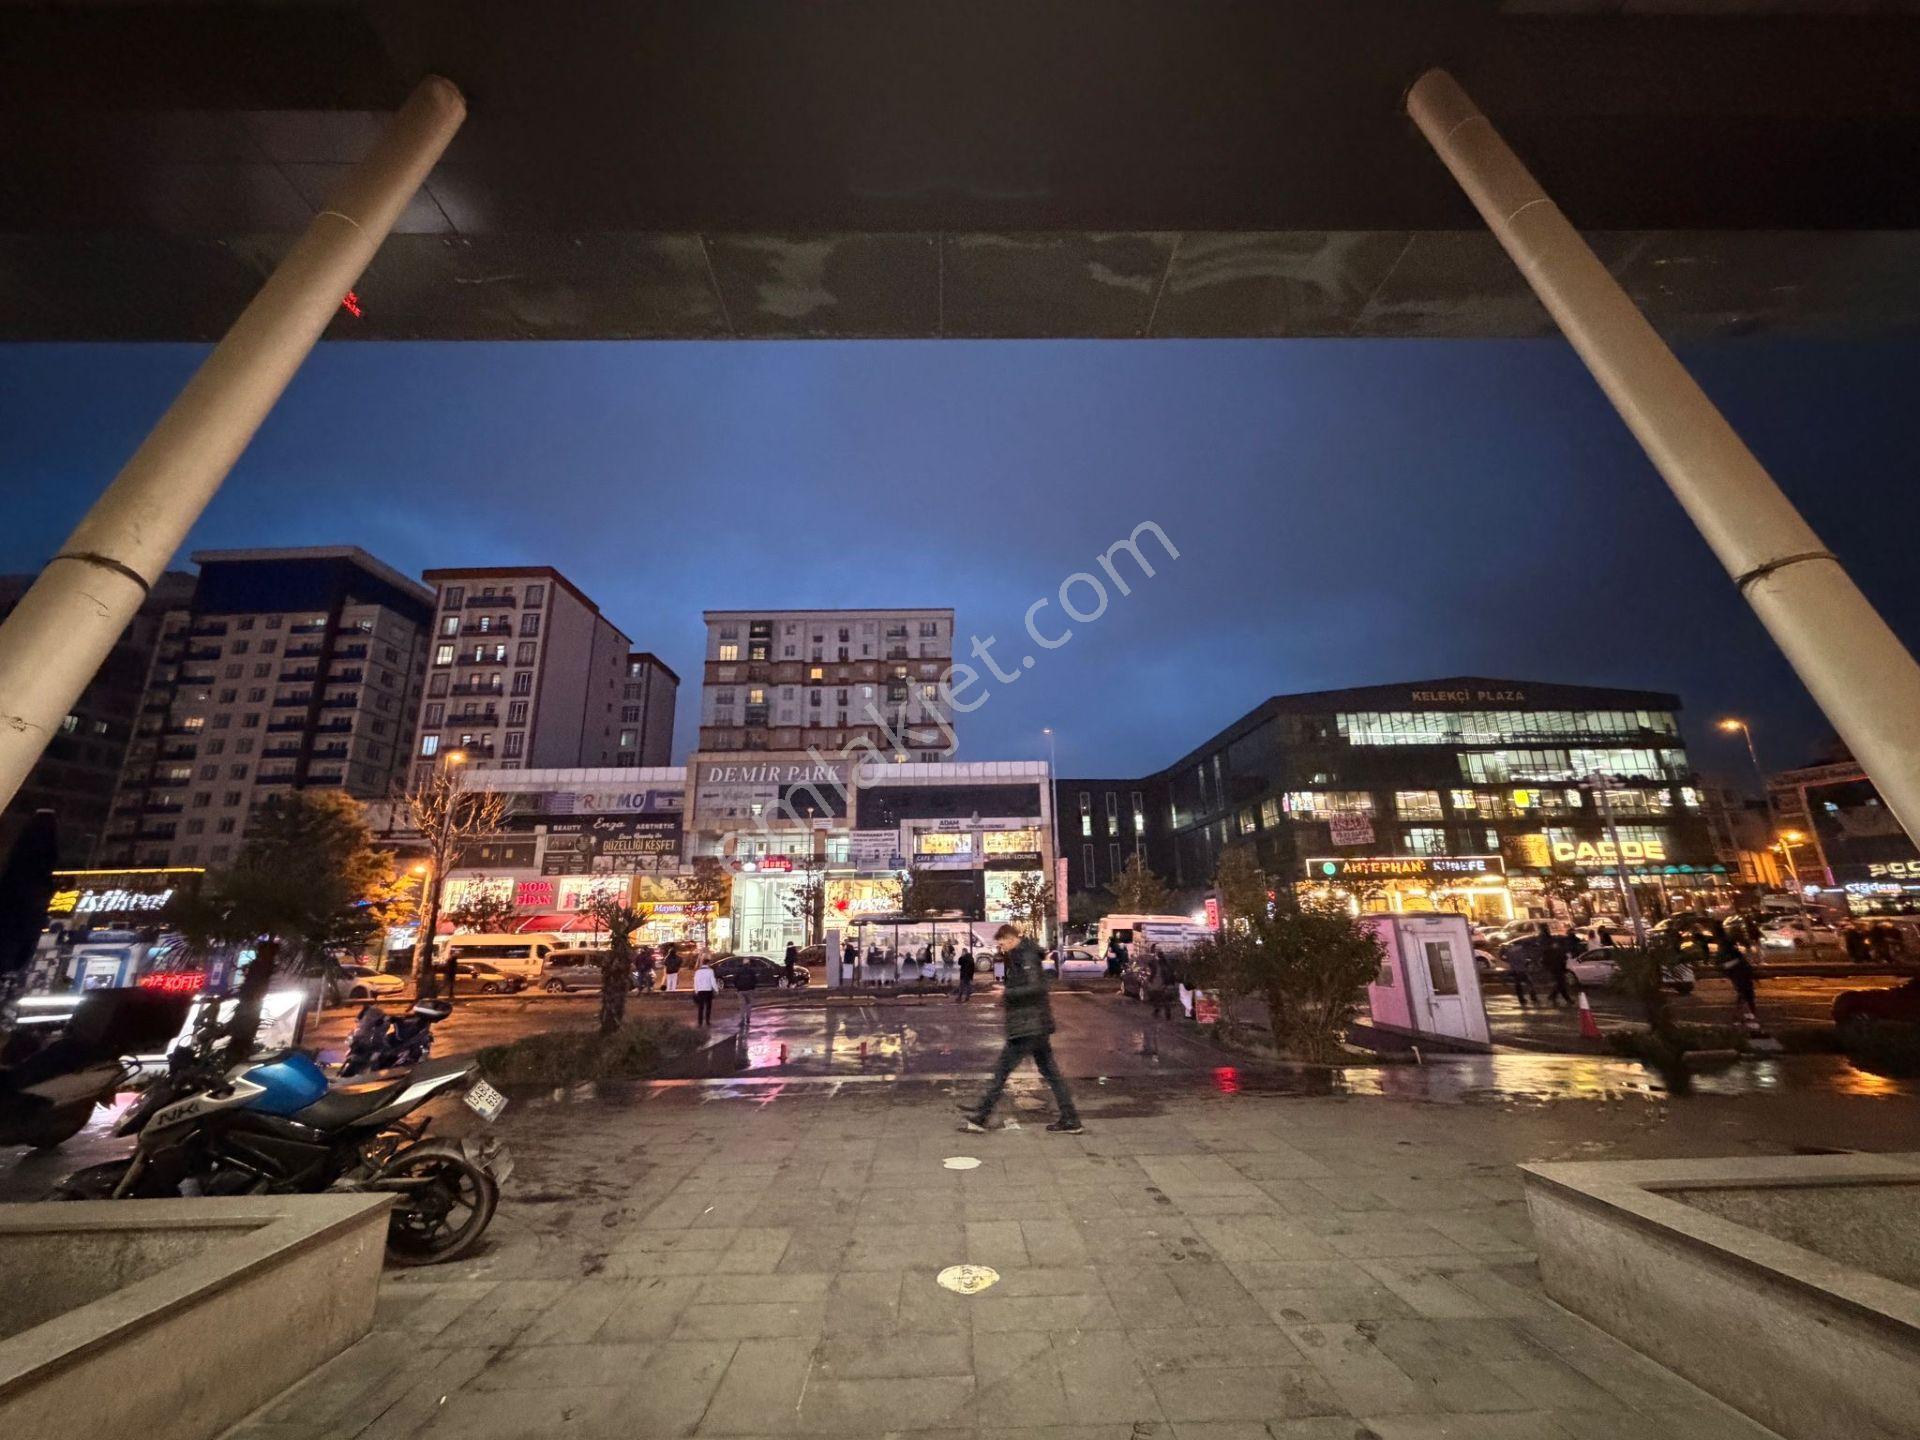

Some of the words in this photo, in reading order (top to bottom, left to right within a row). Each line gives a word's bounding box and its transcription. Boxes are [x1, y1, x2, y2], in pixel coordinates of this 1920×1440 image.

[1411, 689, 1470, 703] KELEKÇİ
[1477, 691, 1525, 701] PLAZA
[708, 762, 781, 782] DEMİR
[787, 765, 841, 781] PARK
